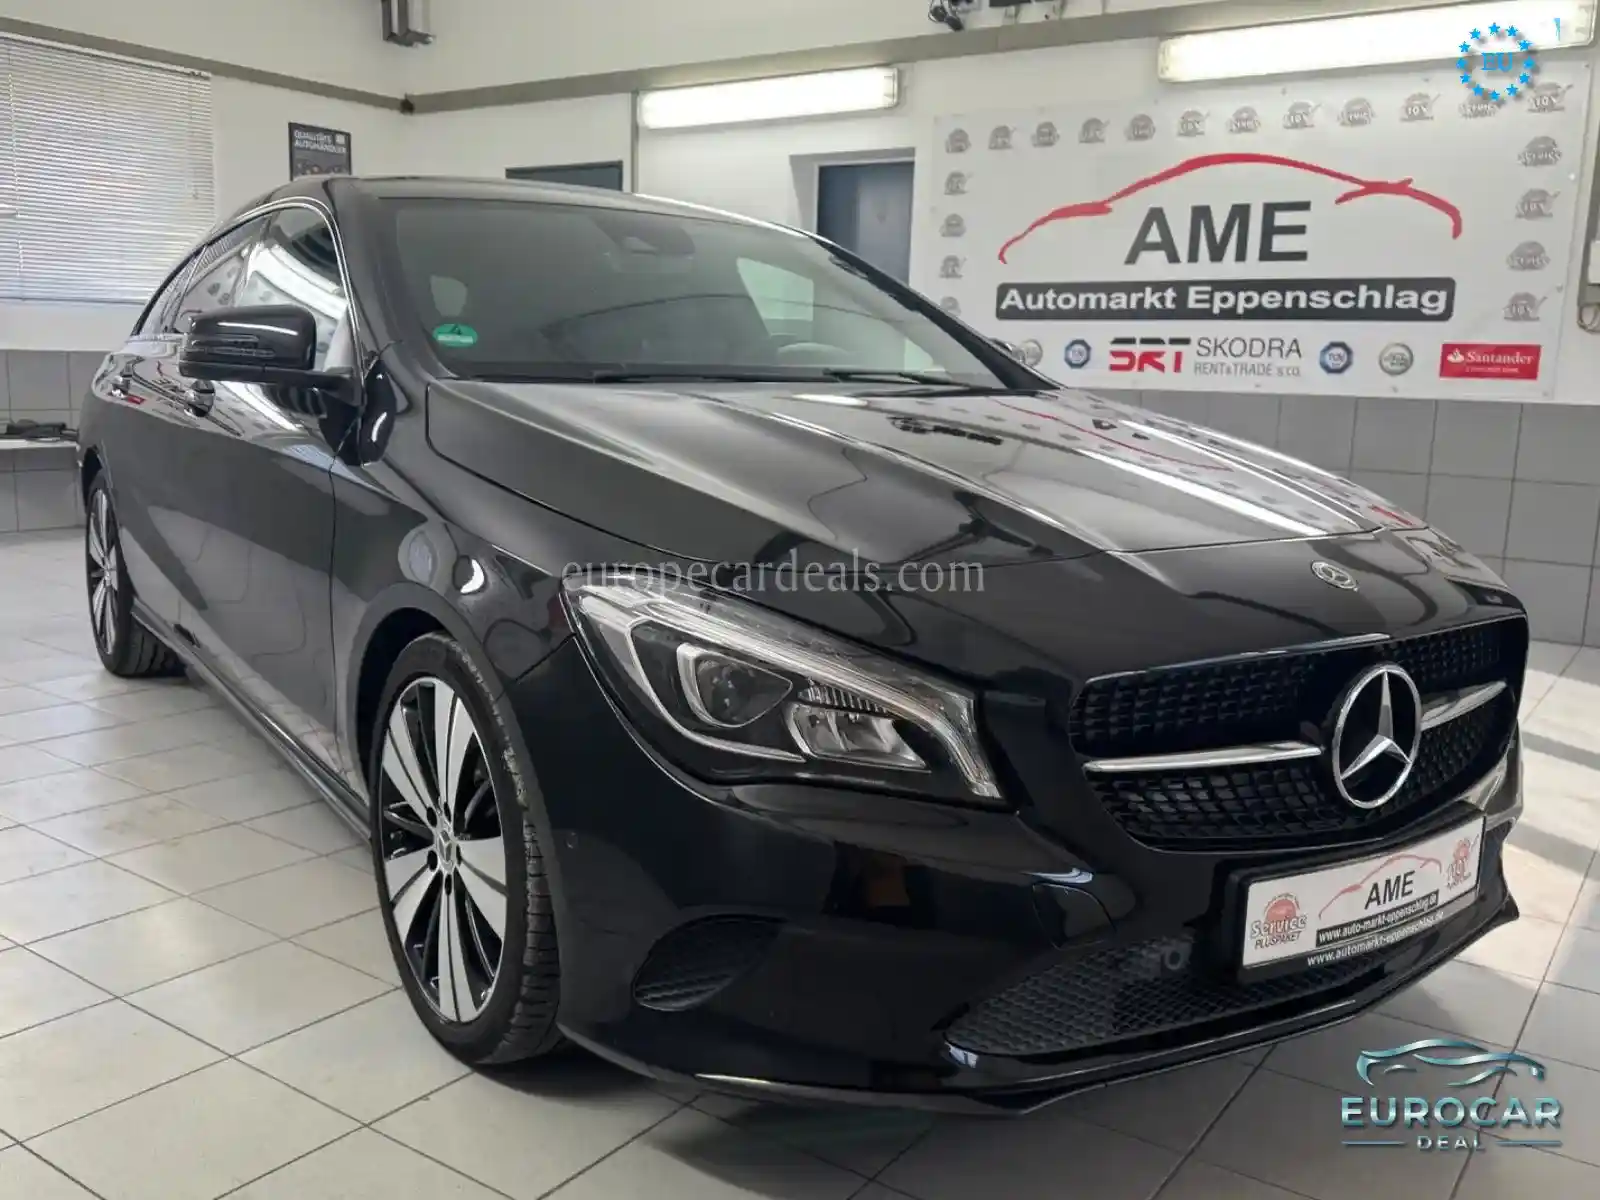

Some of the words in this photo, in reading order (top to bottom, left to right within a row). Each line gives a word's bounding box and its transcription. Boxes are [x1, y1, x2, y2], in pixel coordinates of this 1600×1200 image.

[1124, 200, 1312, 266] AME
[1000, 286, 1176, 311] Automarkt
[1187, 284, 1449, 316] Eppenschlag
[1108, 336, 1192, 374] SRT
[1195, 336, 1303, 360] SKODRA
[1465, 350, 1535, 365] Santander
[1363, 869, 1417, 911] AME
